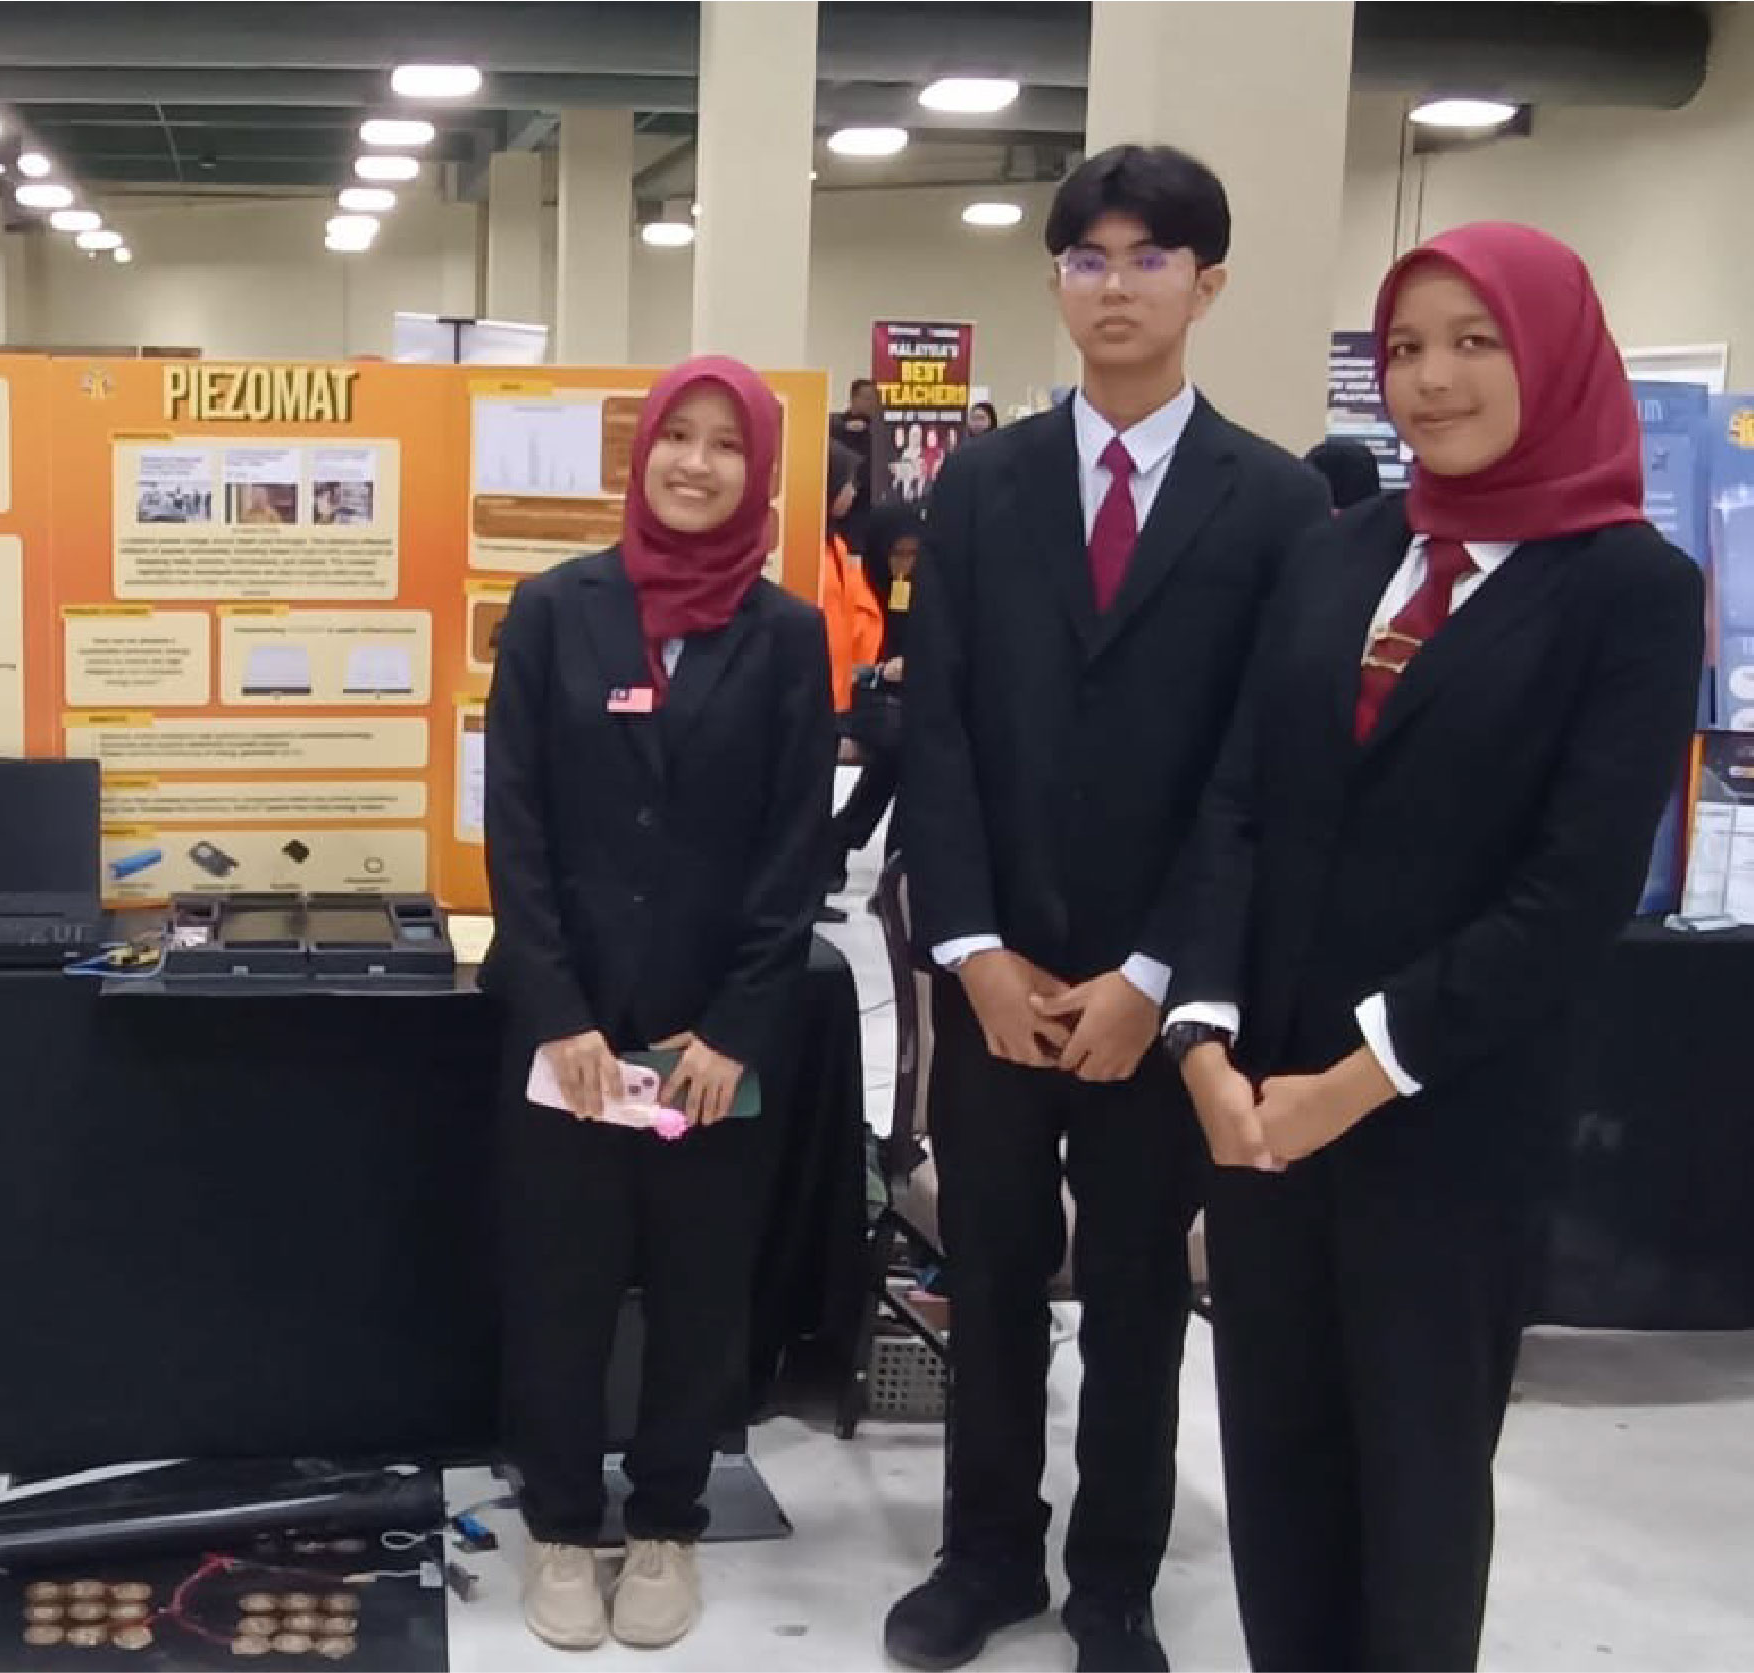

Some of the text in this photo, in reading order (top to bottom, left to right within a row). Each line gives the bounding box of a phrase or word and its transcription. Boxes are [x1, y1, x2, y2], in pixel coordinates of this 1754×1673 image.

[901, 361, 947, 383] BEST
[162, 364, 360, 423] PIEZOMAT
[876, 383, 968, 406] TEACHERS
